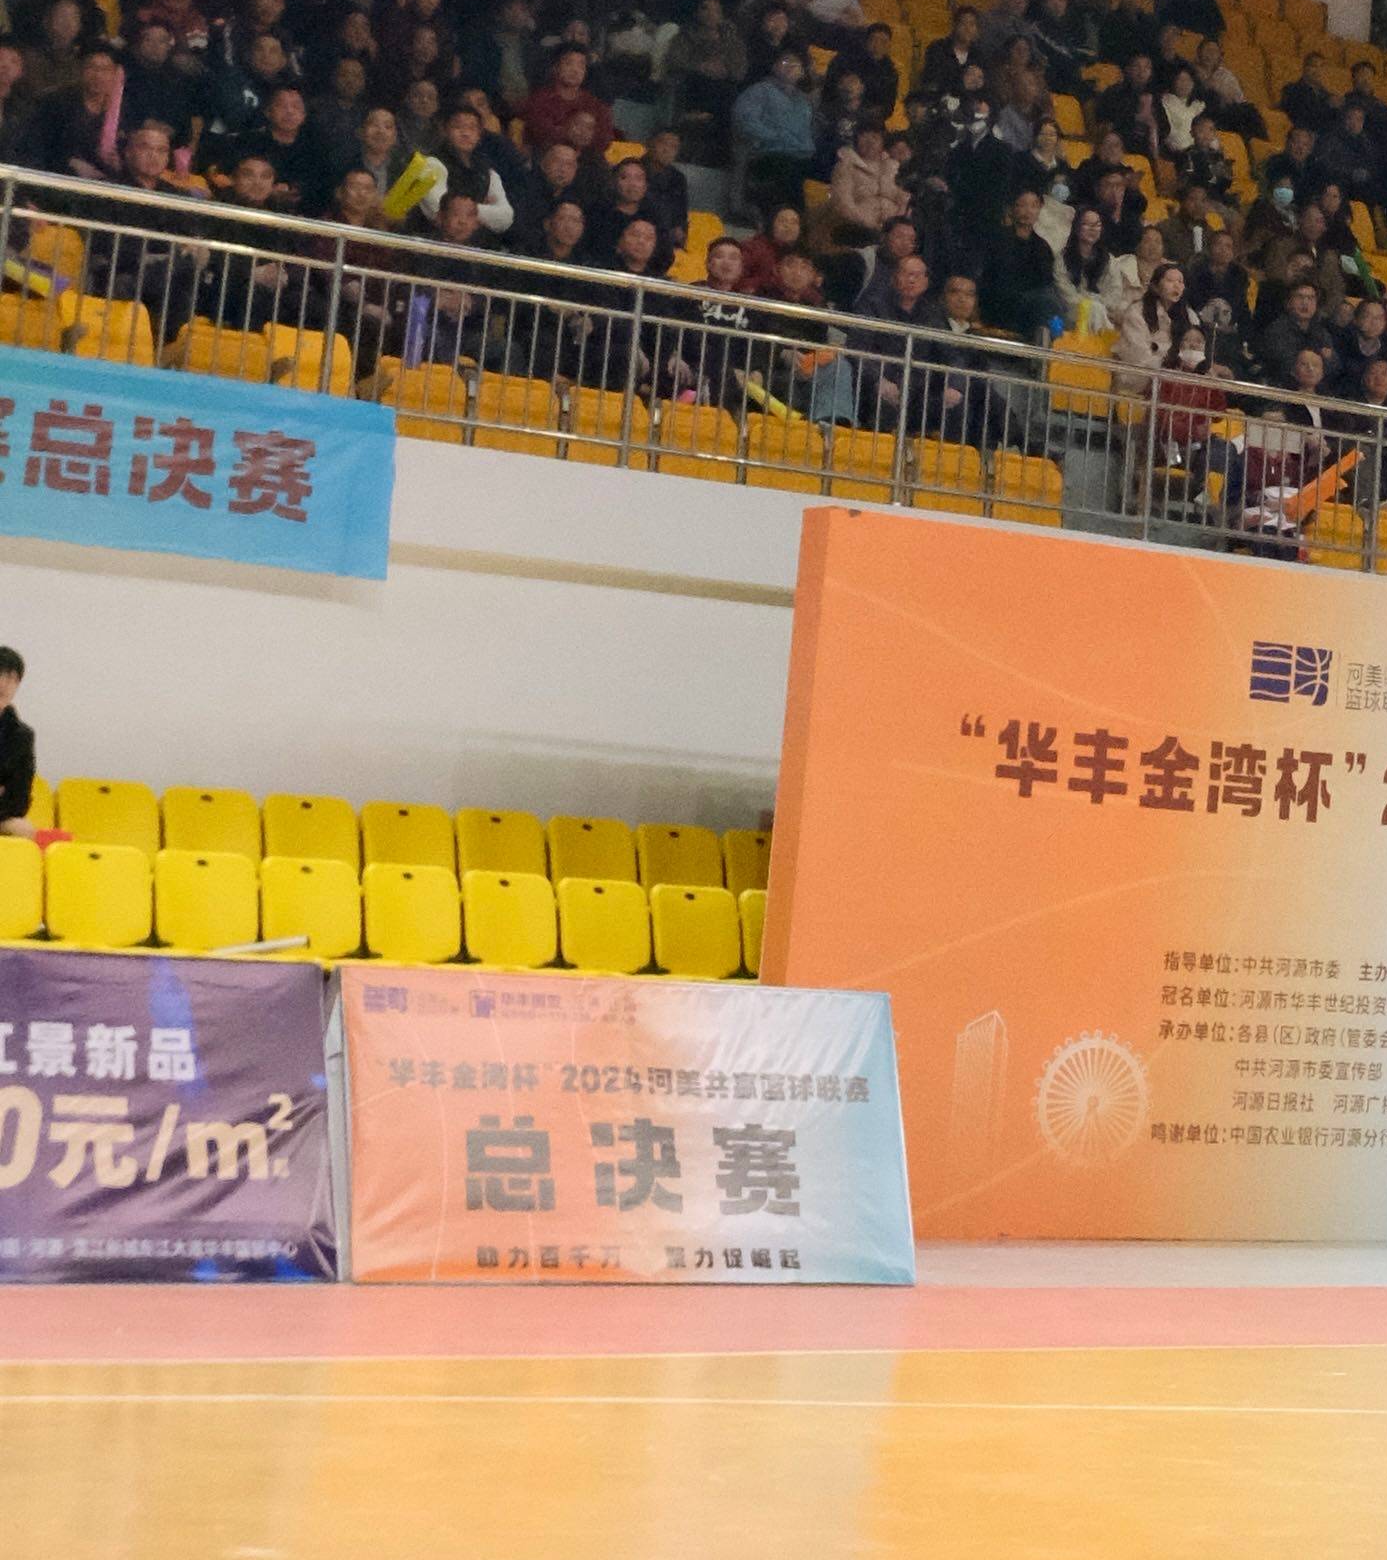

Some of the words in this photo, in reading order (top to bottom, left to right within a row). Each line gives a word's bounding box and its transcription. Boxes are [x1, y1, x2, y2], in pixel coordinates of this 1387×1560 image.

[0, 395, 317, 523] 总决赛
[1163, 950, 1342, 981] 指导单位：中共河源市委
[1233, 1059, 1383, 1082] 中共河源市委宣传部
[1231, 1089, 1315, 1113] 河源日报社
[464, 1115, 800, 1217] 总决赛
